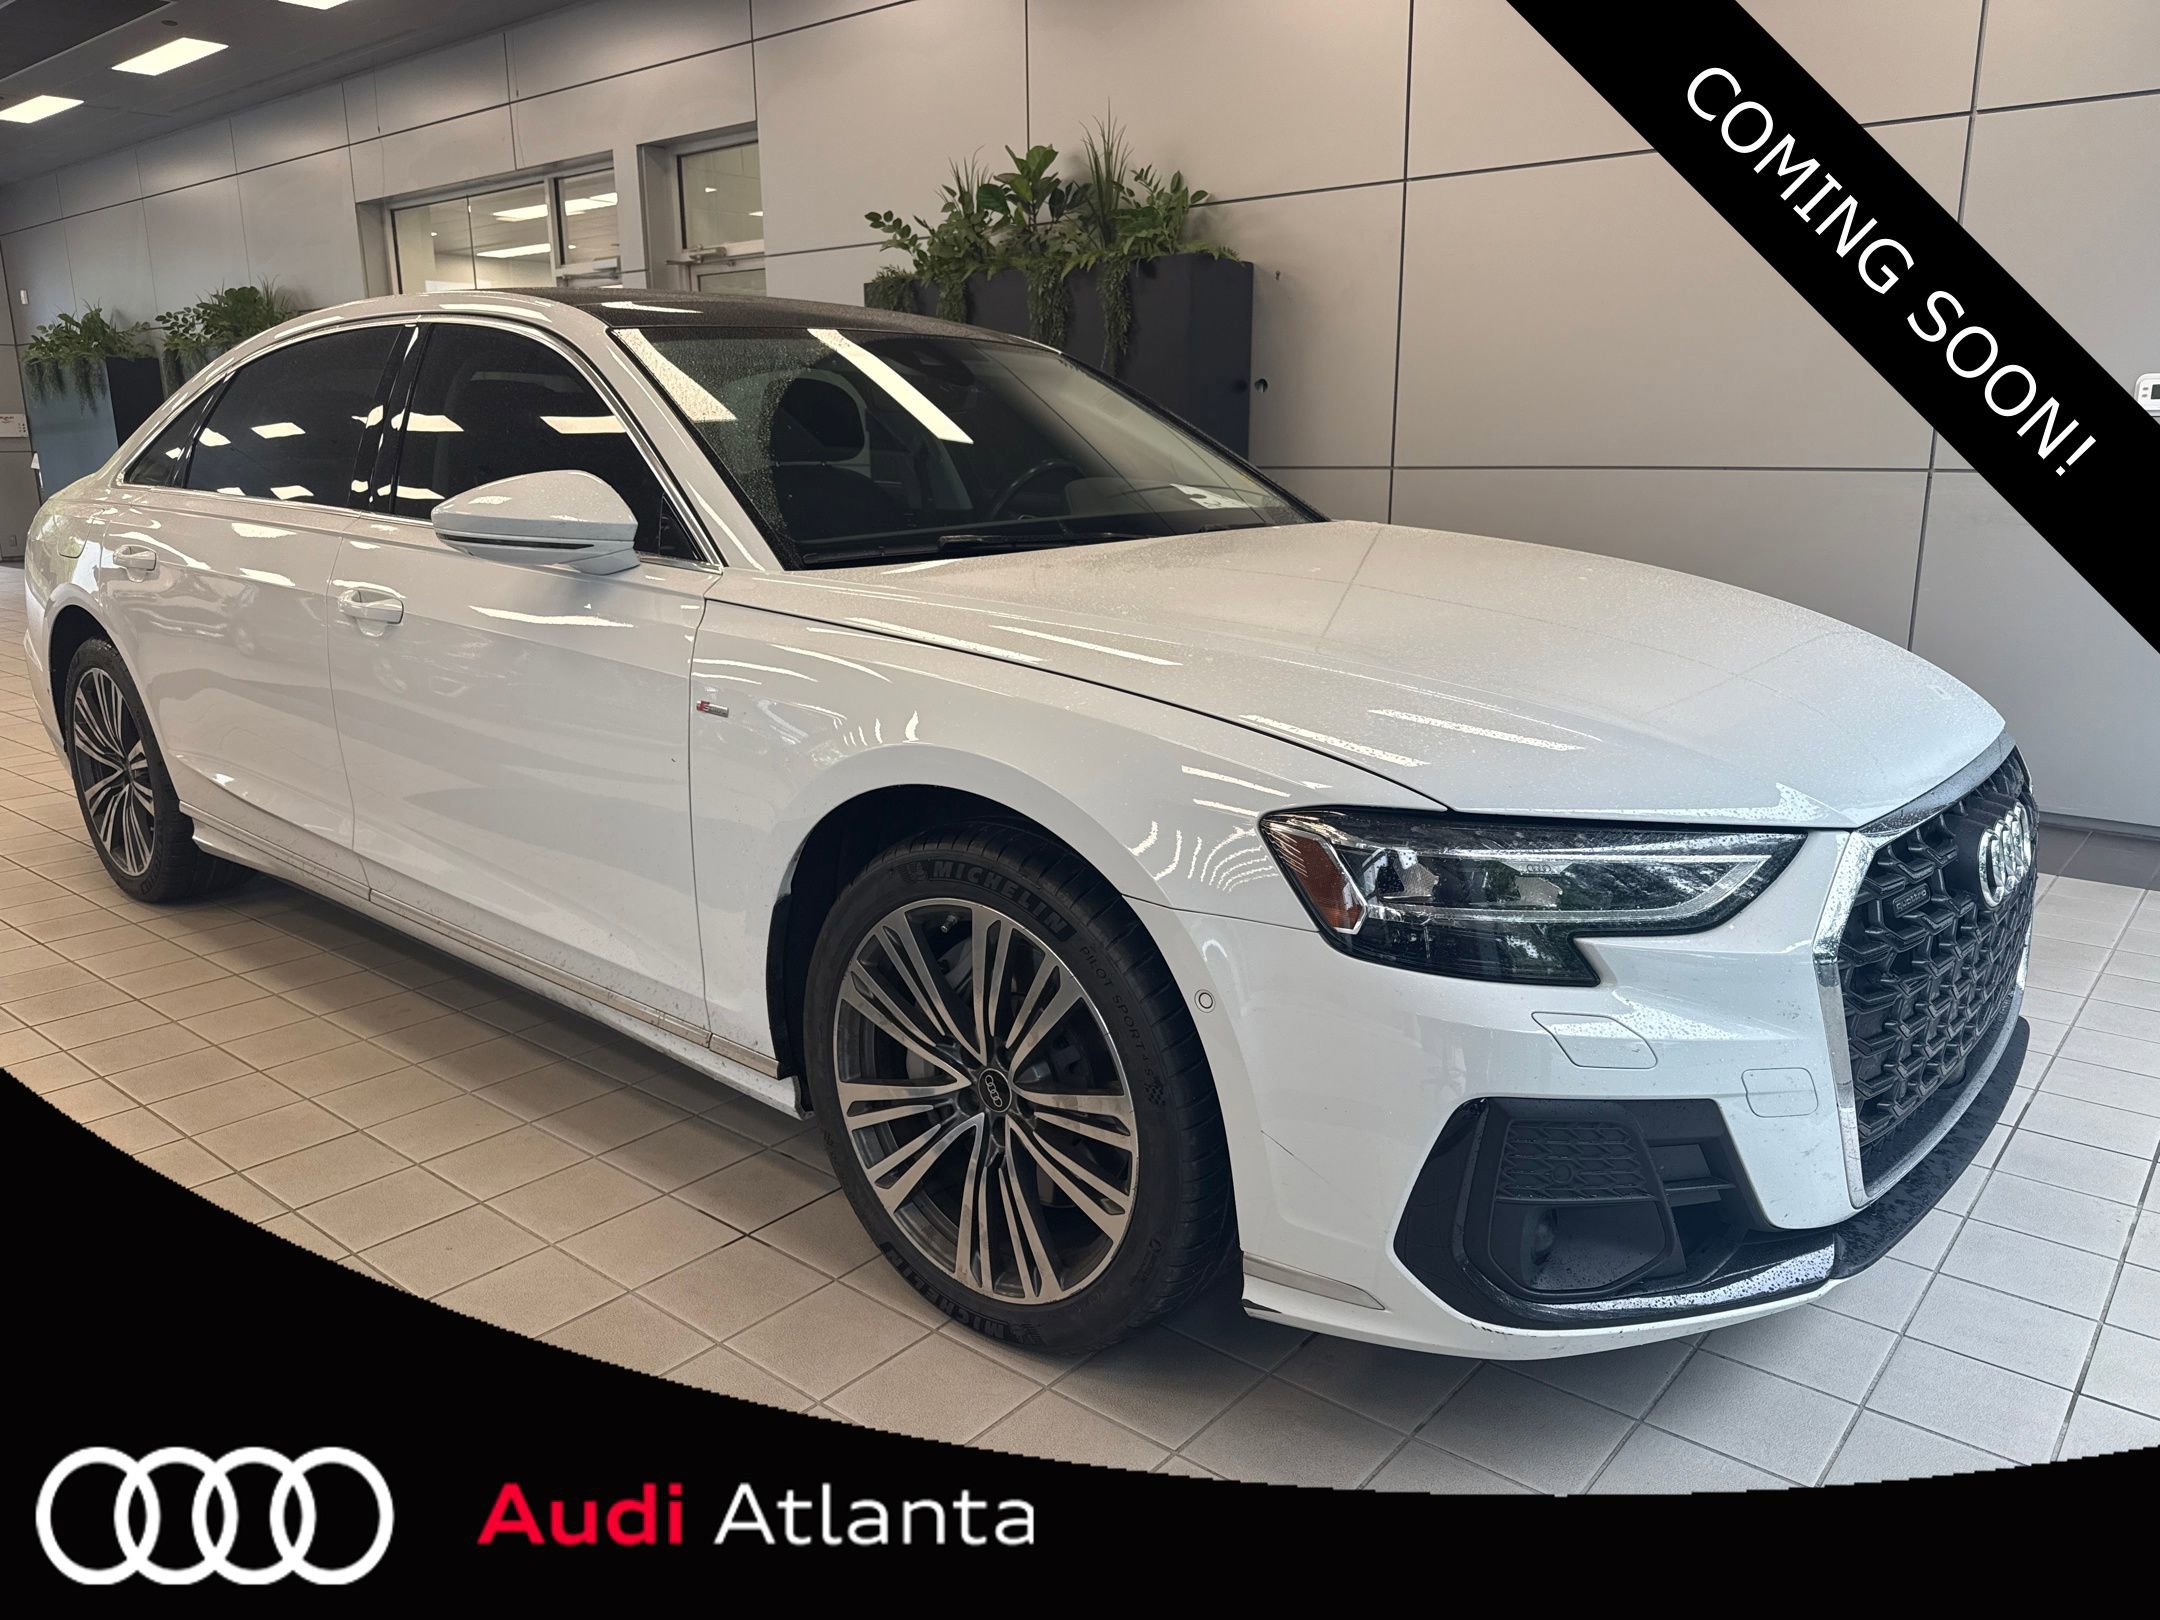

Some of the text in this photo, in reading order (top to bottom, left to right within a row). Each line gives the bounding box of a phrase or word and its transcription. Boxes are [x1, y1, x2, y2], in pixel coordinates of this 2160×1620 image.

[932, 860, 1070, 935] MICHELIN
[1895, 889, 1927, 914] quattro
[1079, 945, 1113, 987] PILOT
[1111, 994, 1147, 1052] SPORT
[885, 1248, 1006, 1339] MICHELIN
